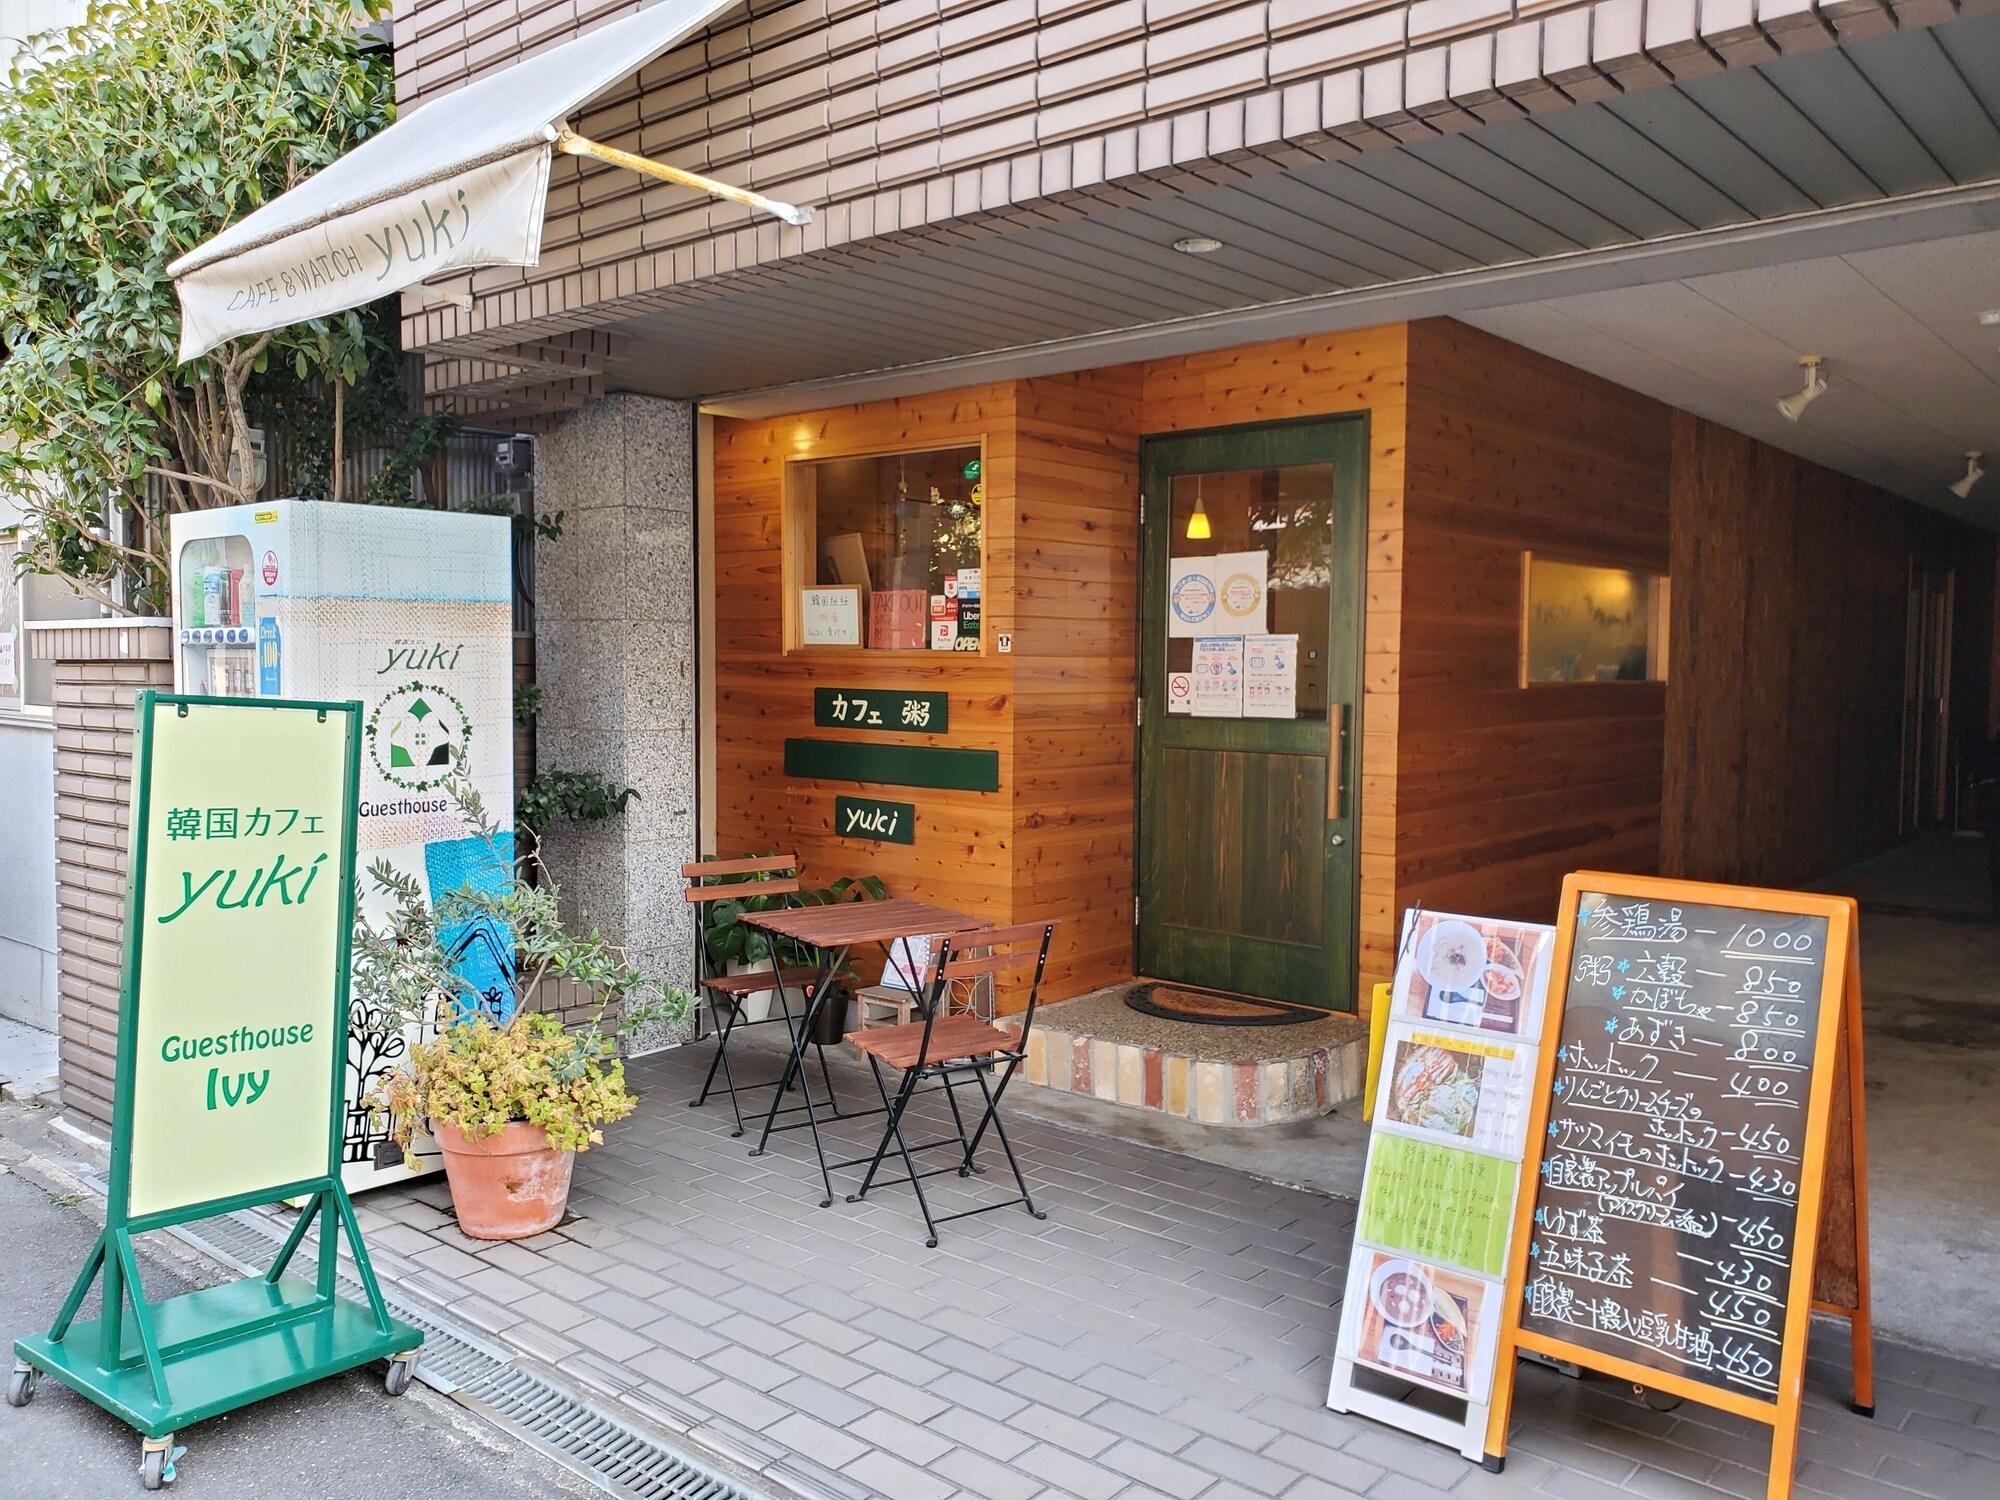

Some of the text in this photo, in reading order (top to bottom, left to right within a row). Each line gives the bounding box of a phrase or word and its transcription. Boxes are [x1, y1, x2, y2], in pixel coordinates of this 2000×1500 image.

[365, 188, 472, 282] yuki
[227, 277, 281, 312] CAFE
[293, 245, 363, 294] WATCH
[377, 642, 464, 675] yuki
[832, 693, 931, 727] カフェ 粥
[166, 807, 325, 841] 韓国カフェ
[359, 798, 448, 818] Guesthouse
[846, 807, 899, 836] yuki
[157, 852, 328, 924] yuki
[1591, 898, 1813, 951] 参鶏湯 1000
[1574, 954, 1614, 986] 粥
[1633, 951, 1802, 993] 六穀 850
[1630, 987, 1799, 1027] かぼちゃ 850
[161, 1023, 313, 1062] Guesthouse
[1618, 1016, 1797, 1061] あずき 800
[206, 1067, 270, 1110] Ivy
[1568, 1040, 1789, 1096] ホットック 400
[1562, 1075, 1703, 1121] りんごとクリームチーズの
[1559, 1117, 1797, 1196] サツマイモのホットック 430
[1649, 1117, 1791, 1154] ホットック 450
[1543, 1205, 1773, 1292] ゆず茶 430
[1736, 1215, 1785, 1250] 450
[1540, 1240, 1771, 1327] 五味子茶 450
[1722, 1336, 1774, 1378] 450
